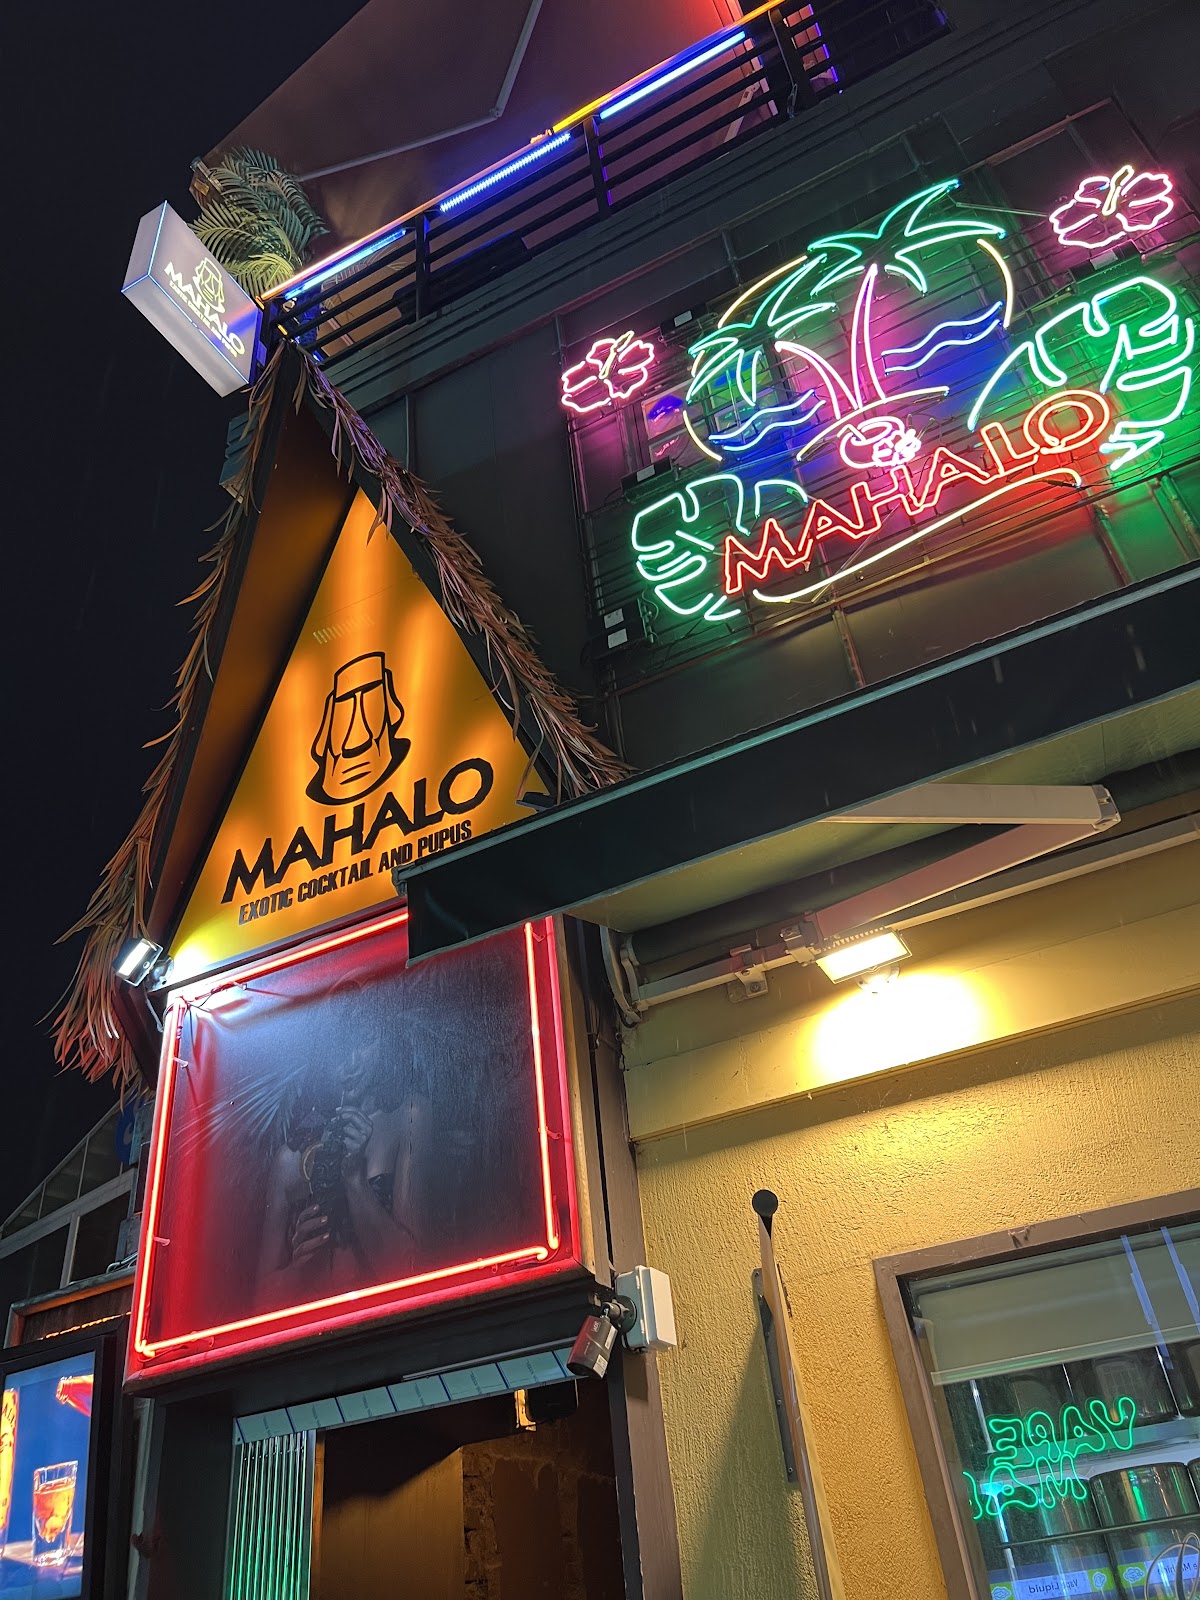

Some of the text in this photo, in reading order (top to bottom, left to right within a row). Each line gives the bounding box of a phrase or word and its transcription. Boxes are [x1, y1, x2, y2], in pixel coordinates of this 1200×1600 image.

[164, 261, 246, 355] MAHALO
[724, 389, 1111, 595] MAHALO
[221, 757, 494, 904] MAHALO
[238, 819, 472, 926] EXOTIC COCKTAIL AND PUPUS
